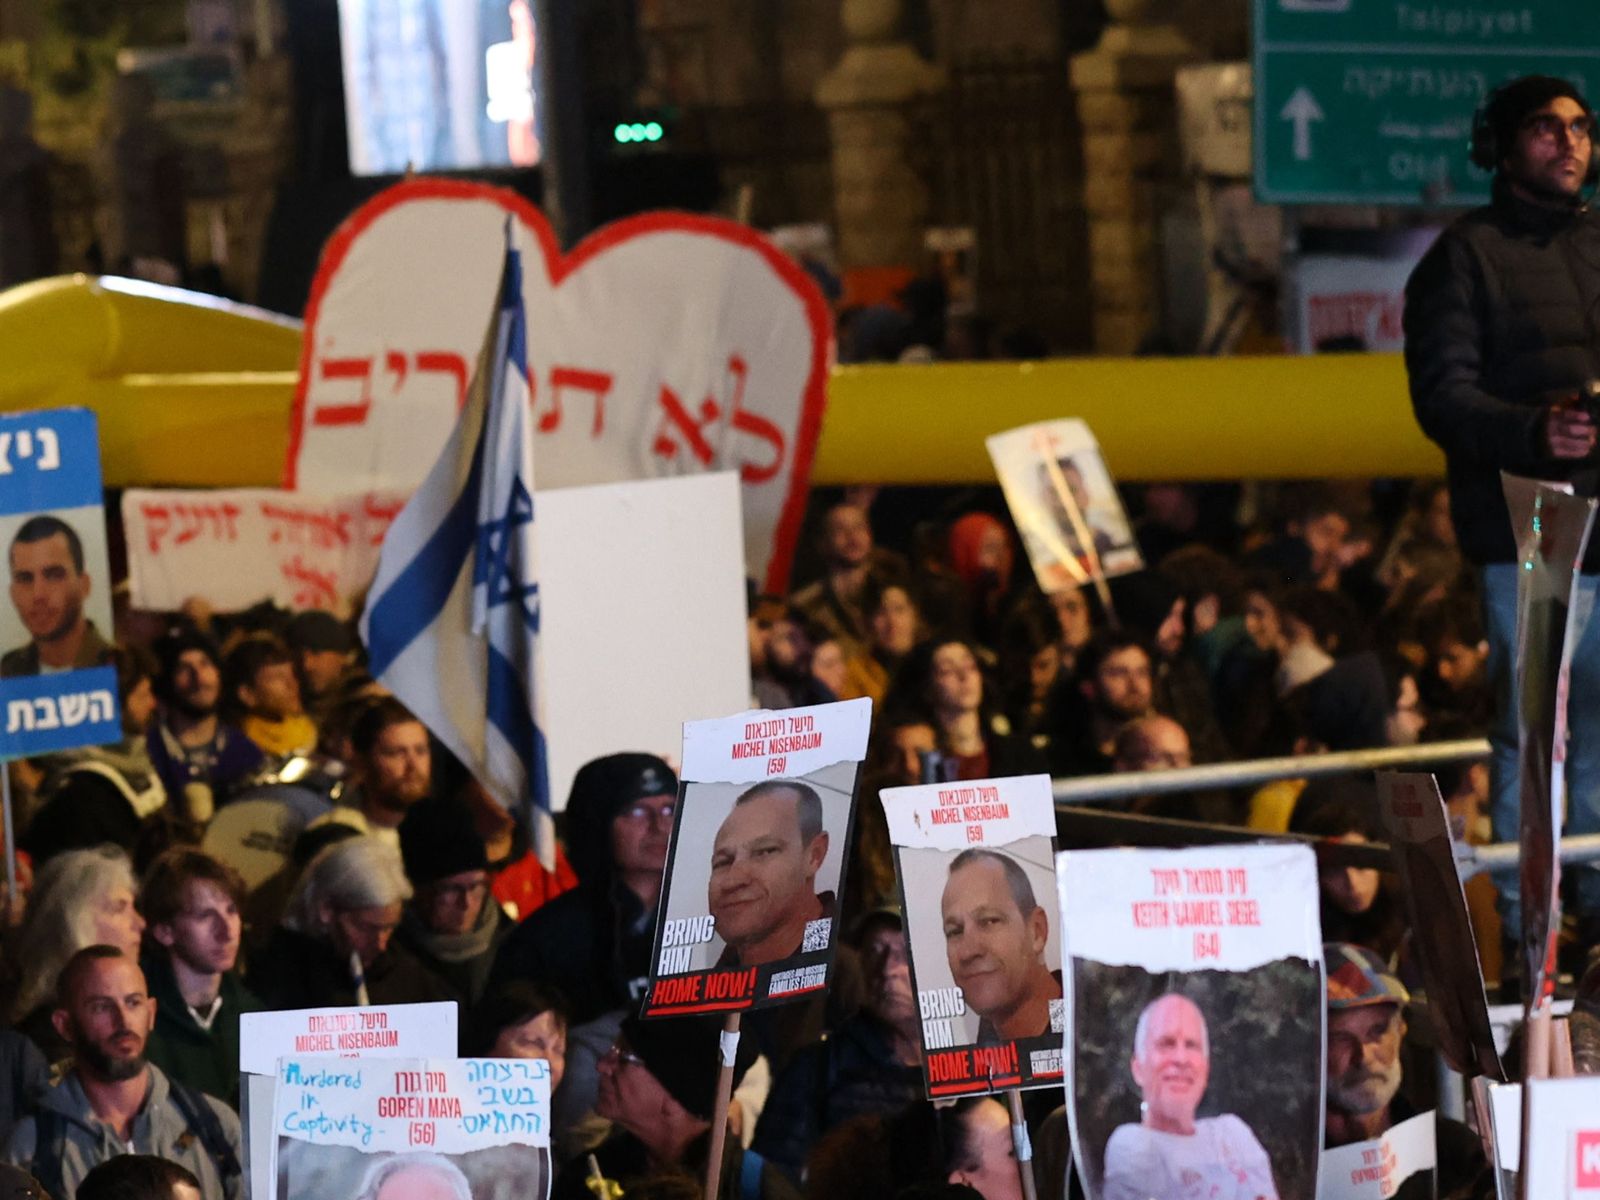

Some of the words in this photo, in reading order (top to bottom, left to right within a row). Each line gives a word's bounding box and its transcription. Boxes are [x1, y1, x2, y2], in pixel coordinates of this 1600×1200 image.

[313, 351, 613, 438] תריב
[653, 352, 785, 484] לא
[6, 689, 115, 733] השבת
[788, 715, 814, 735] מישל
[731, 740, 765, 759] MICHEL
[768, 733, 822, 755] NISENBAUM
[766, 757, 787, 776] (59)
[930, 807, 962, 825] MICHEL
[963, 804, 1009, 821] NISENBAUM
[966, 825, 984, 843] (59)
[662, 915, 715, 948] BRING
[657, 948, 692, 976] HIM
[652, 975, 703, 1005] HOME
[704, 966, 759, 1000] NOW!
[918, 986, 966, 1019] BRING
[359, 1012, 387, 1029] מישל
[296, 1033, 335, 1052] MICHEL
[338, 1031, 398, 1049] NISENBAUM
[922, 1019, 954, 1050] HIM
[928, 1050, 971, 1082] HOME
[973, 1040, 1020, 1077] NOW!
[285, 1063, 361, 1089] Murdered
[394, 1072, 422, 1095] גורן
[425, 1071, 447, 1093] מיה
[378, 1098, 424, 1118] GOREN
[428, 1096, 462, 1118] MAYA
[408, 1122, 436, 1147] (56)
